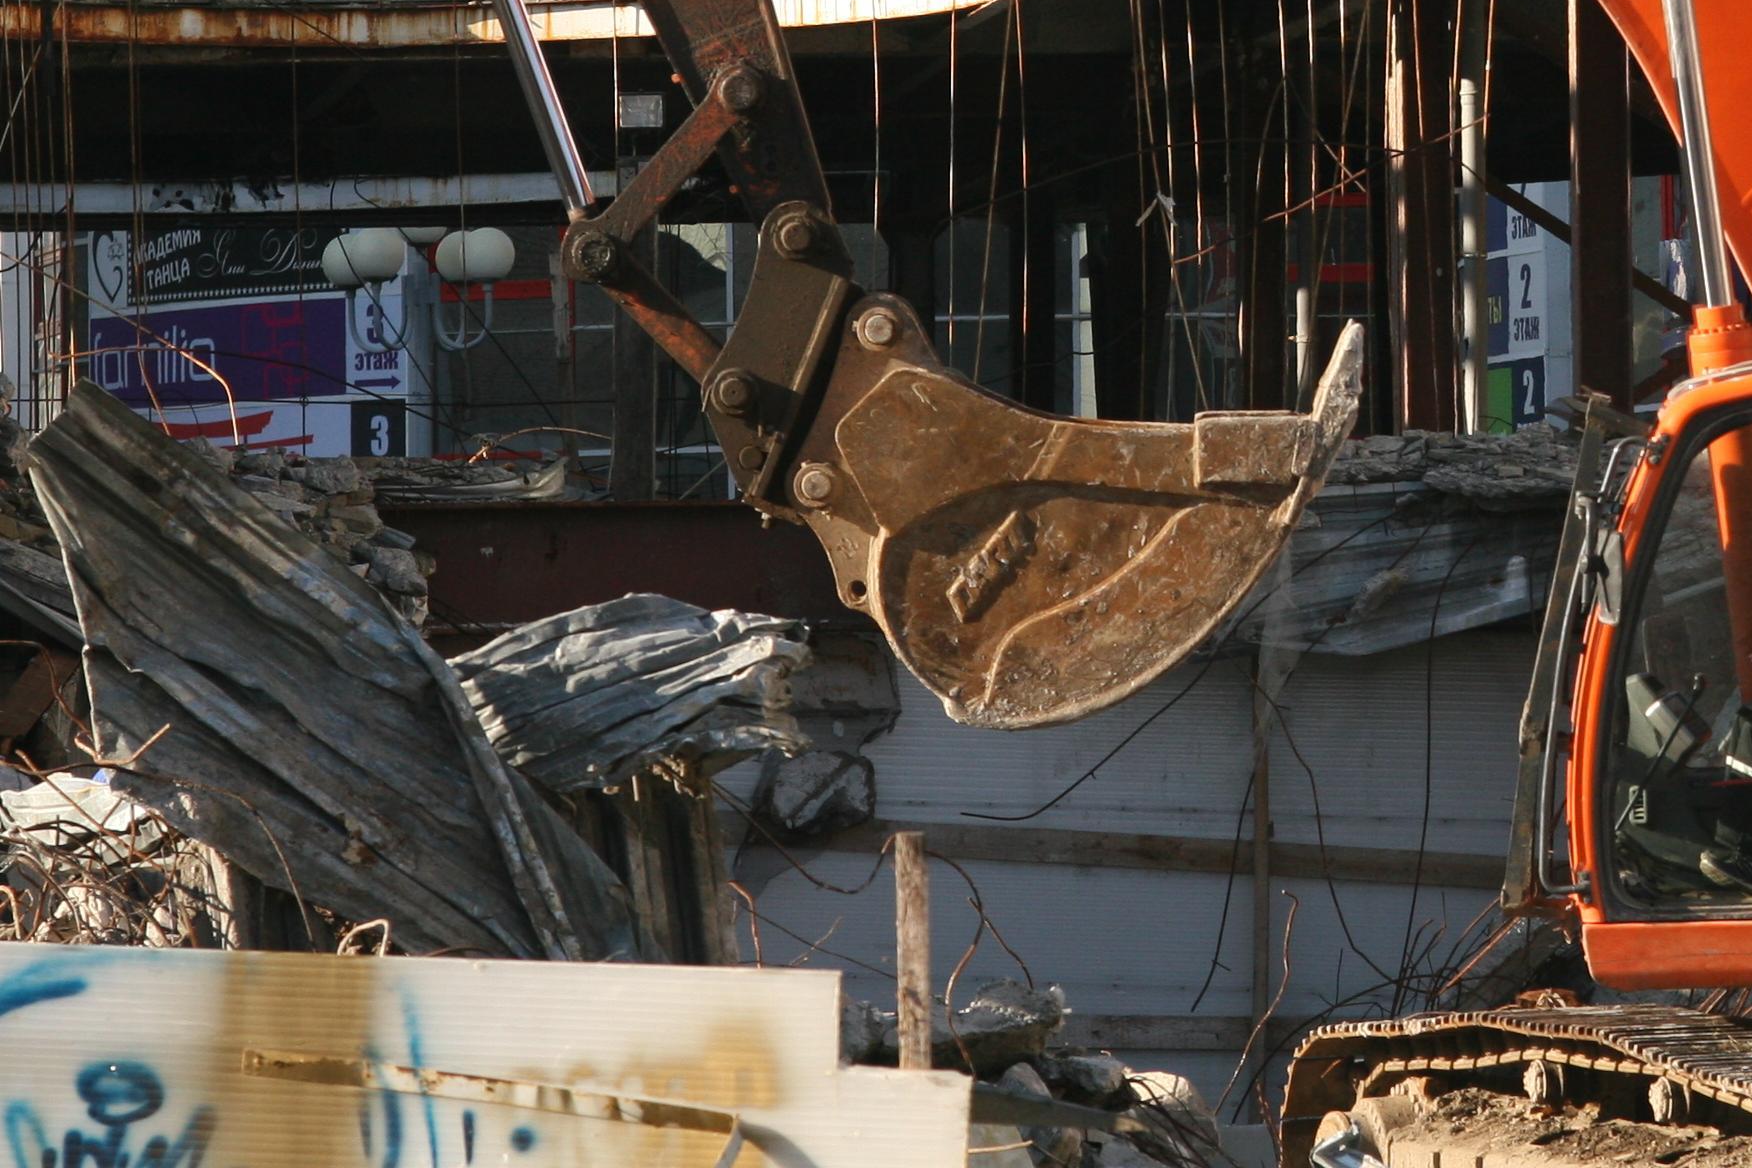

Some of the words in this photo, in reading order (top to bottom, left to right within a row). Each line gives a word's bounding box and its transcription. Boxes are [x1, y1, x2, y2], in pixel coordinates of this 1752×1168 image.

[146, 257, 191, 290] ТАНЦА
[1520, 263, 1532, 309] 2
[366, 304, 384, 344] 3
[1522, 369, 1535, 415] 2
[370, 415, 389, 457] 3
